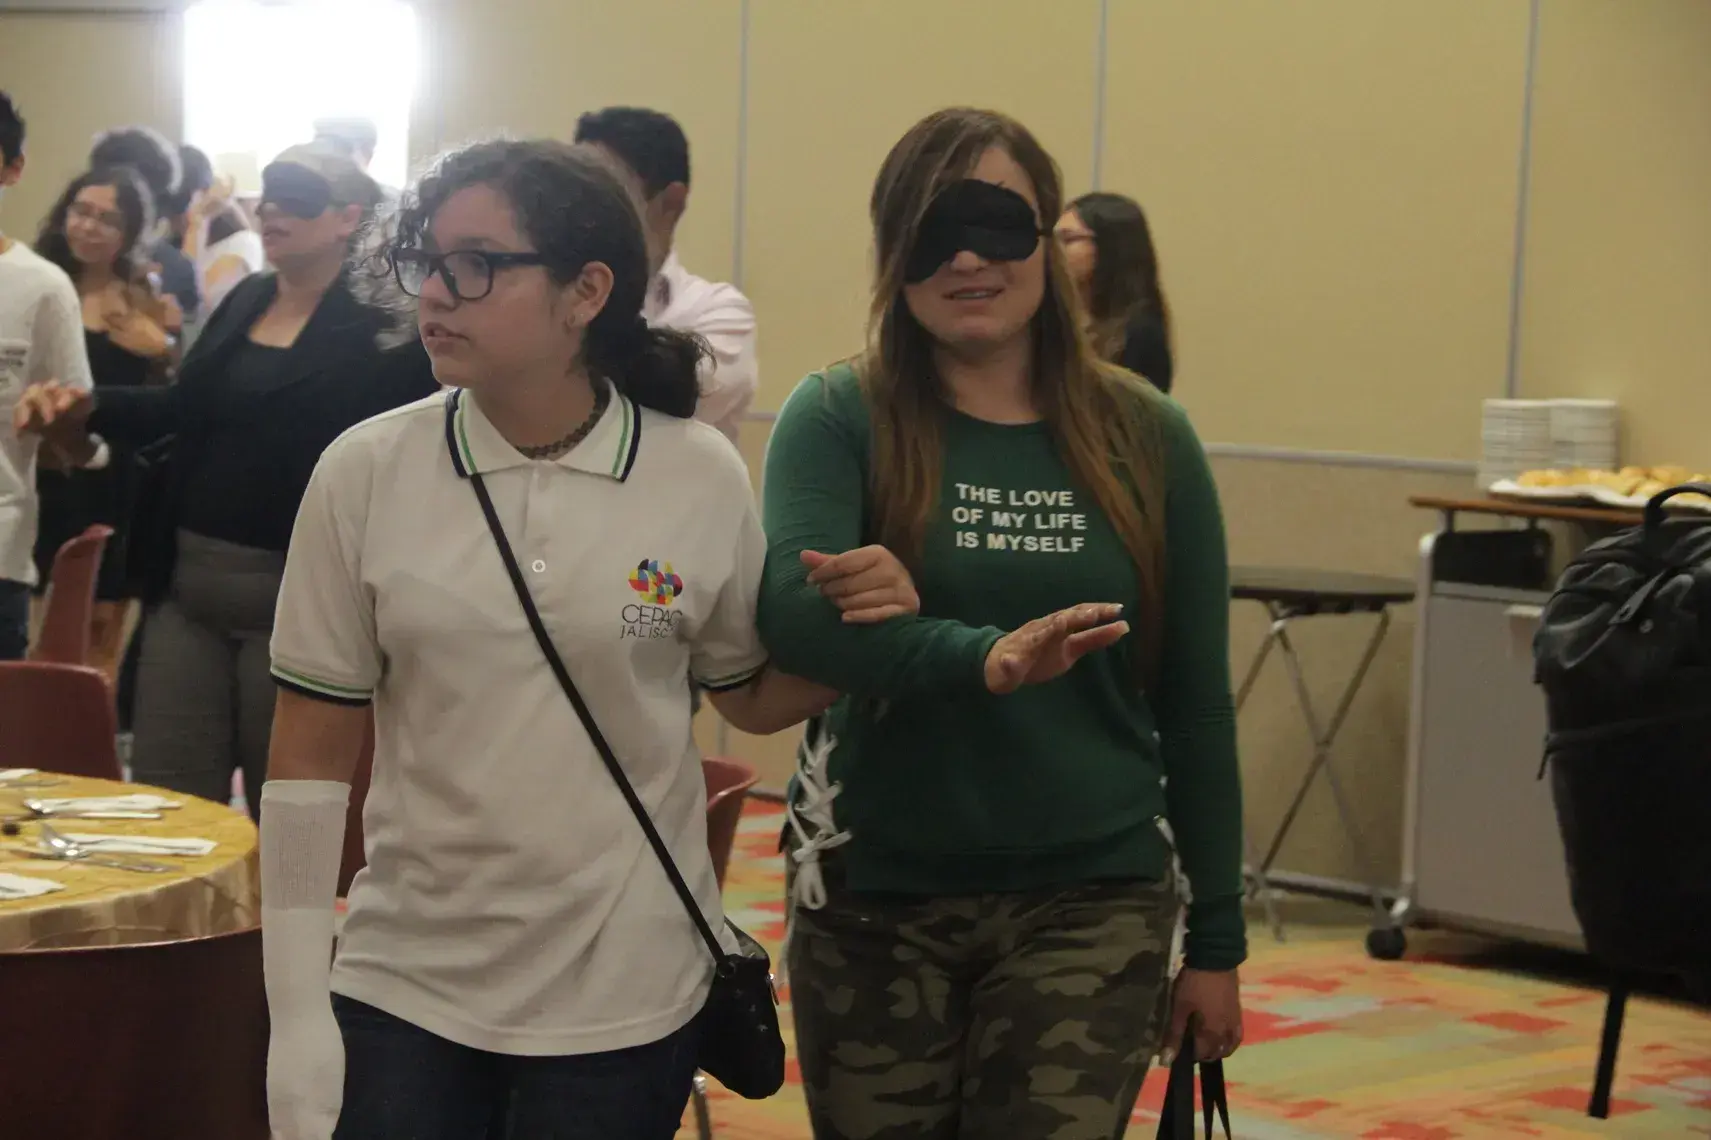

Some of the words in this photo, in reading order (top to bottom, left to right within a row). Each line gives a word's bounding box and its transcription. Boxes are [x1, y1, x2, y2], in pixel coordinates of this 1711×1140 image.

[955, 483, 1002, 504] THE
[1008, 490, 1075, 507] LOVE
[952, 506, 984, 524] OF
[991, 511, 1027, 528] MY
[1034, 513, 1088, 530] LIFE
[956, 531, 980, 548] IS
[986, 533, 1085, 553] MYSELF
[620, 624, 675, 639] JALISC
